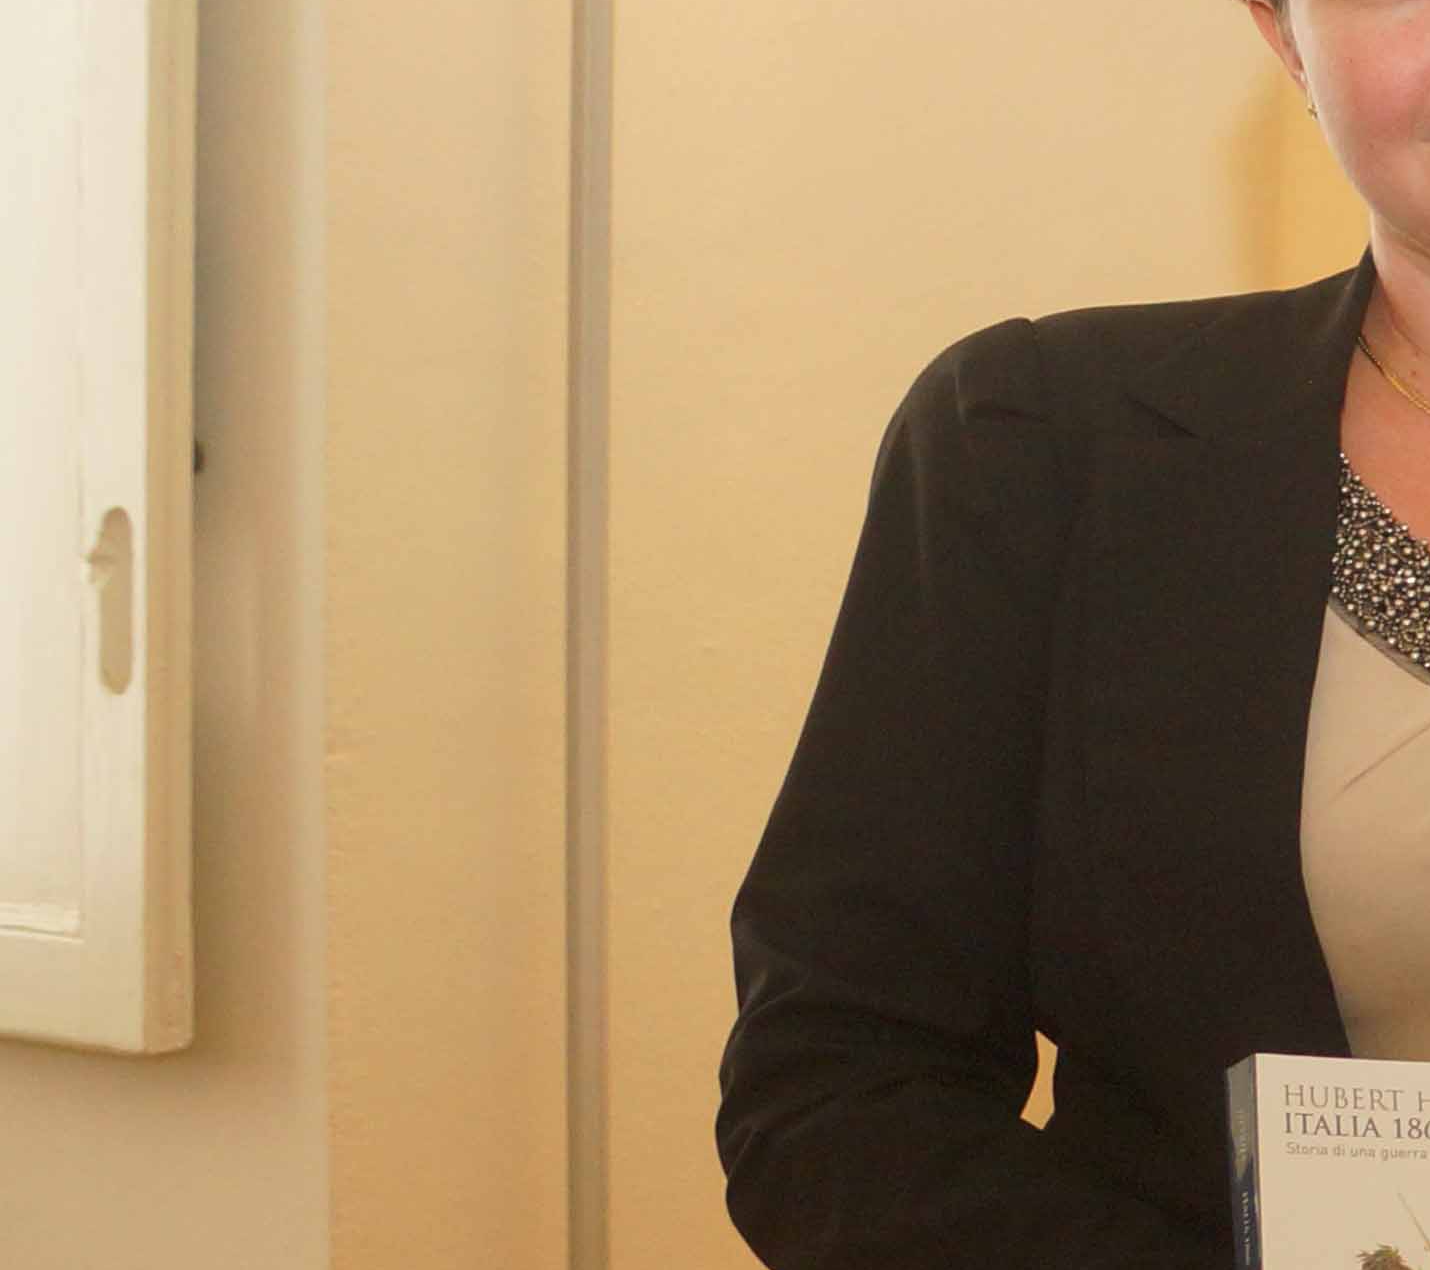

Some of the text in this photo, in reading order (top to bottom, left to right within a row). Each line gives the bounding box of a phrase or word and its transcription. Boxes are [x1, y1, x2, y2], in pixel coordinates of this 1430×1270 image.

[1284, 1084, 1404, 1112] HUBERT
[1285, 1112, 1383, 1139] ITALIA
[1286, 1142, 1329, 1156] Storia
[1332, 1144, 1346, 1157] di
[1351, 1147, 1376, 1158] una
[1382, 1147, 1428, 1162] guerra
